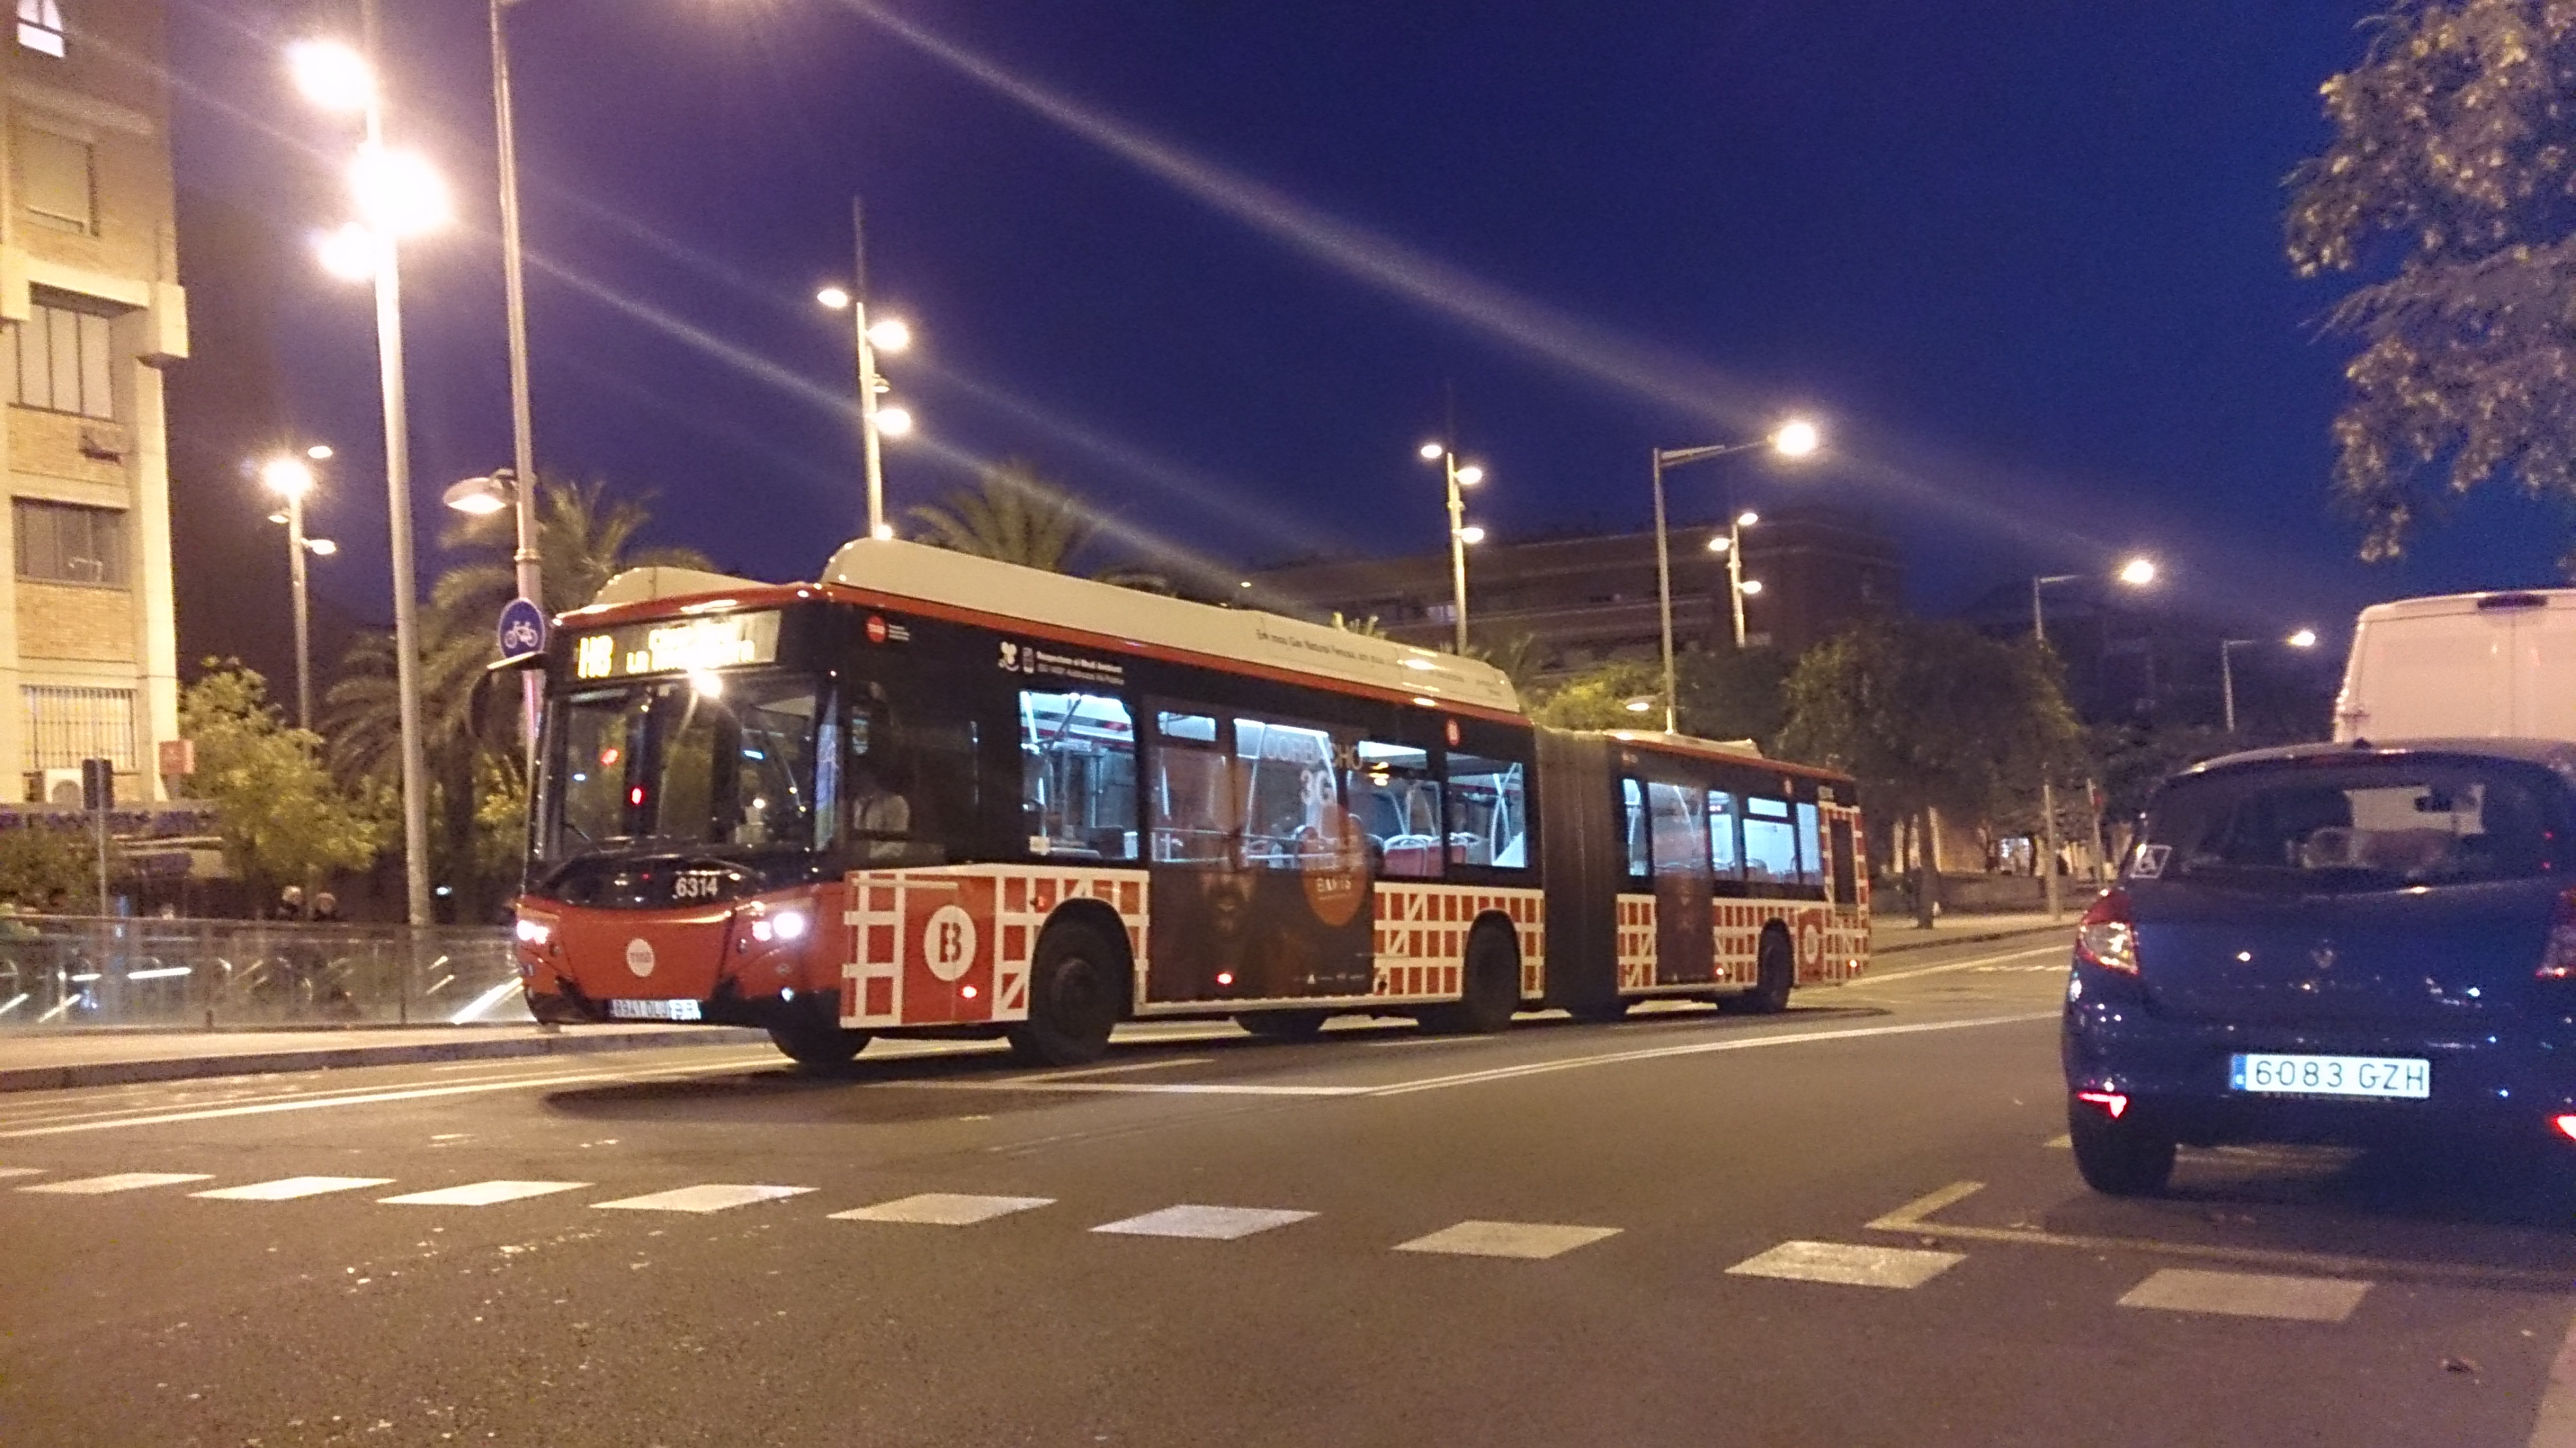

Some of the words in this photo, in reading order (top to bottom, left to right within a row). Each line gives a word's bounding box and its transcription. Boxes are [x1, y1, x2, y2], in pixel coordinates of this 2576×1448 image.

[675, 876, 718, 898] 6314
[939, 922, 962, 963] B
[2255, 1060, 2343, 1088] 6083
[2358, 1062, 2424, 1091] GZH
